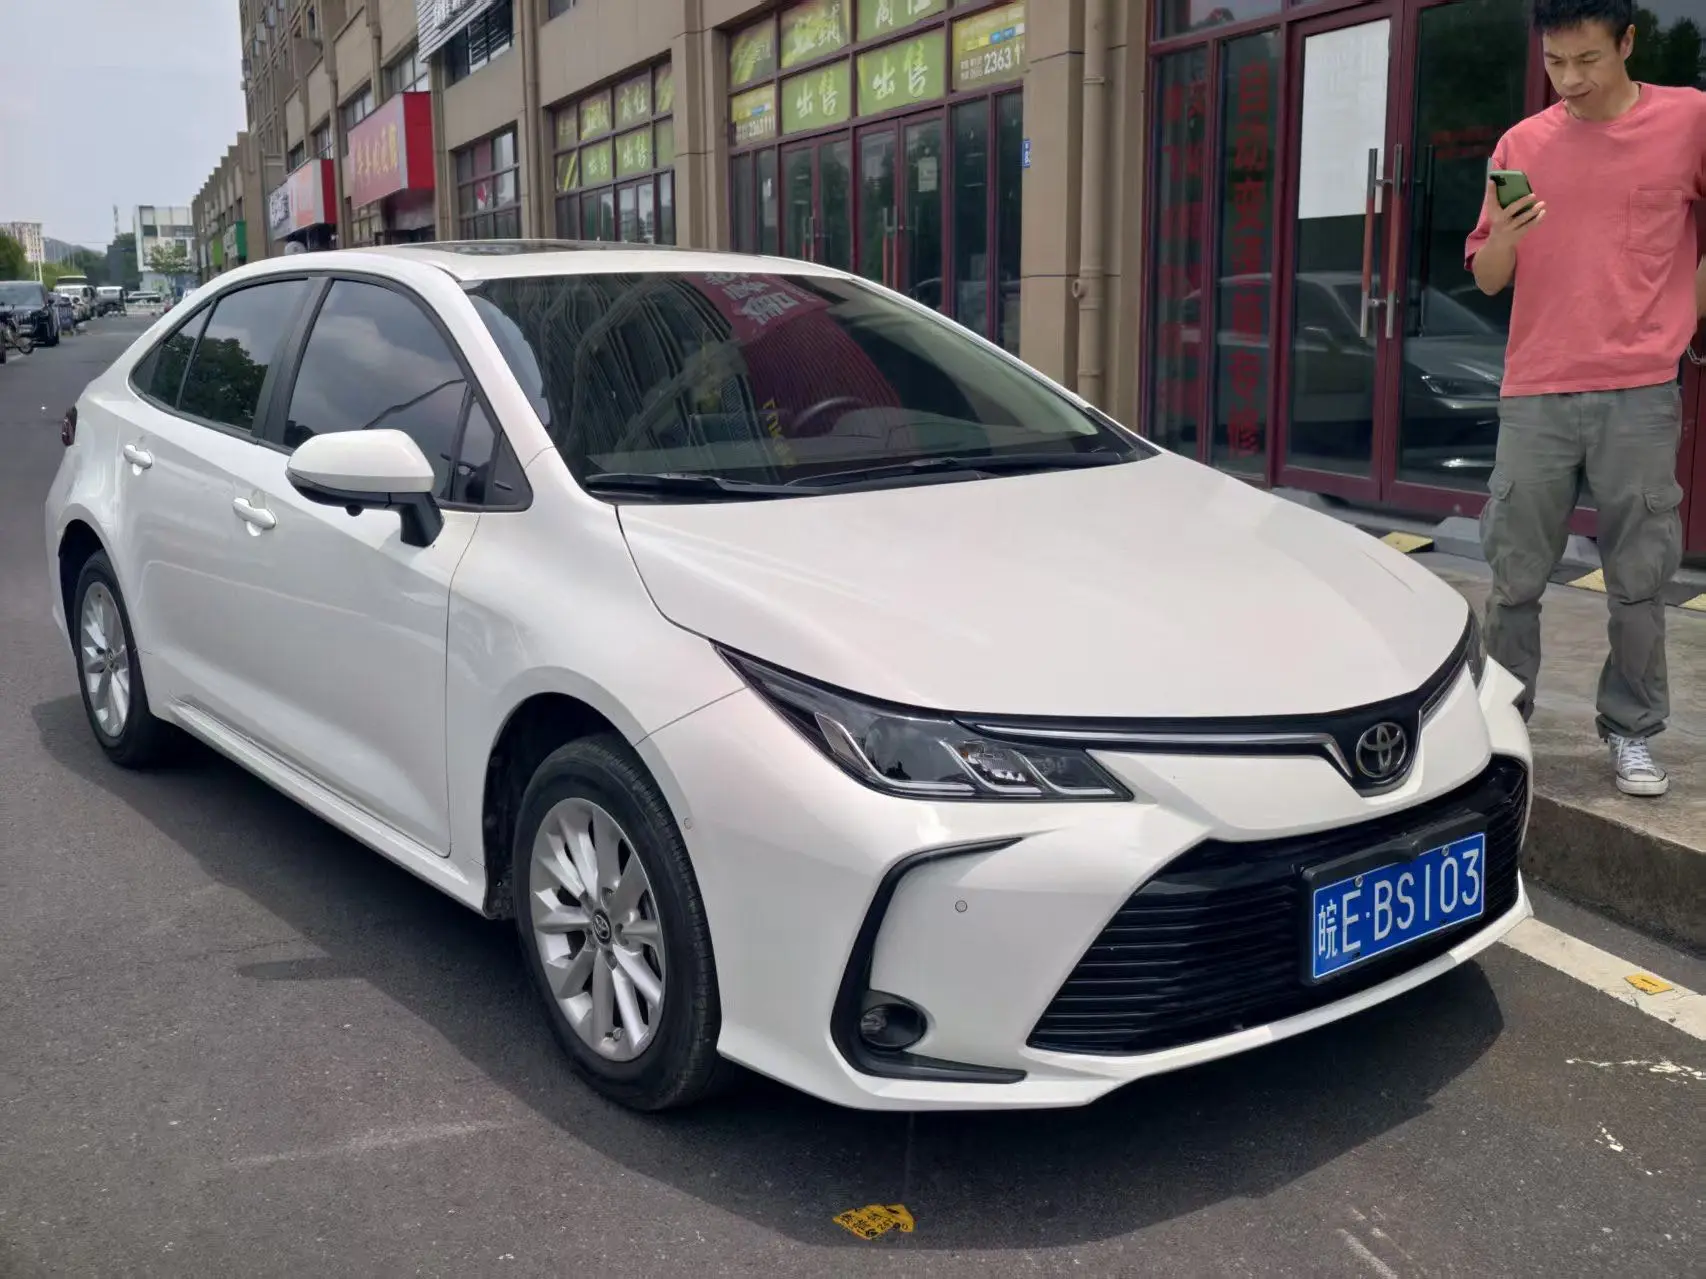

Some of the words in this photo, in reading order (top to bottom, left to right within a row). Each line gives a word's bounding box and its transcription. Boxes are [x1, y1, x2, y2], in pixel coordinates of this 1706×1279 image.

[796, 69, 838, 119] 出售
[872, 39, 929, 101] 出售
[1226, 60, 1269, 457] 自动变速箱专修
[1318, 848, 1480, 961] 皖E·BS103
